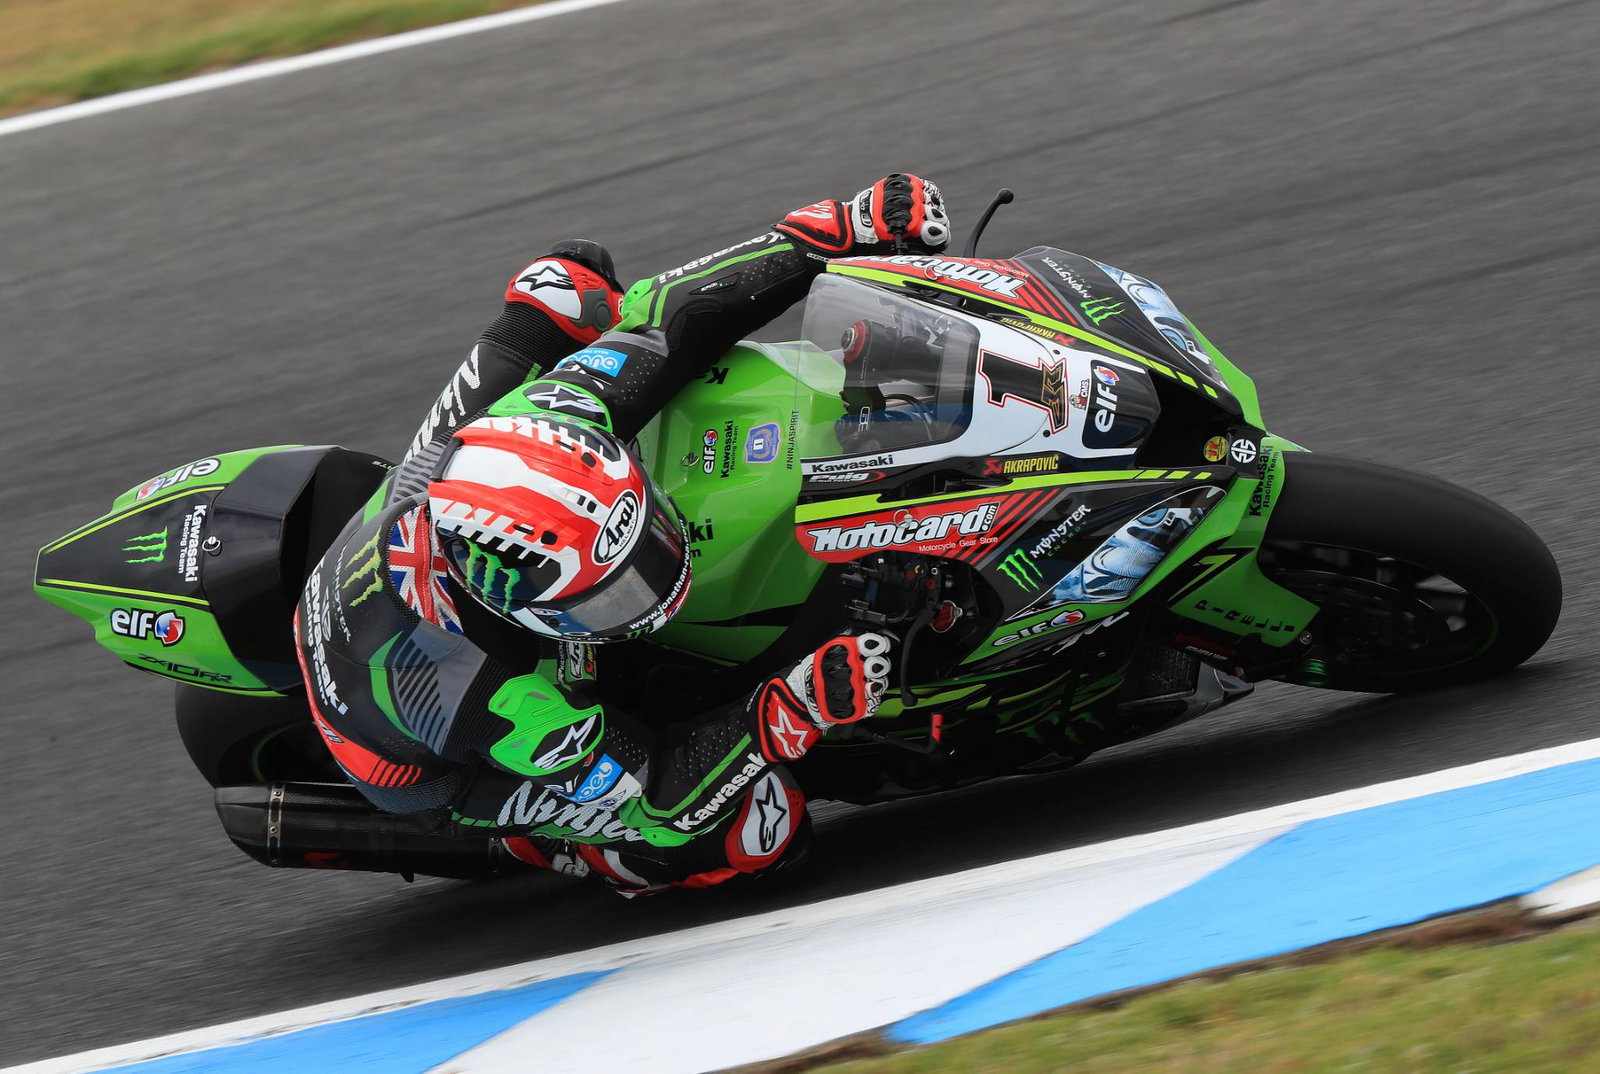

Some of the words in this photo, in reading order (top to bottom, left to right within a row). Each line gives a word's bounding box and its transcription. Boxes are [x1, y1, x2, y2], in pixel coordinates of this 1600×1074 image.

[1094, 383, 1118, 433] elf
[720, 419, 734, 479] Kawasaki
[786, 409, 799, 470] #NINJASPIRIT
[161, 458, 220, 489] elf
[703, 446, 716, 474] elf
[729, 446, 737, 471] Racing
[812, 454, 894, 473] Kawasaki
[1249, 445, 1275, 517] Kawasaki
[1262, 474, 1275, 508] Racing
[180, 514, 193, 547] Racing
[185, 504, 207, 582] Kawasaki
[602, 496, 635, 560] Arai
[919, 541, 957, 552] Motorcycle
[959, 538, 977, 548] Gear
[979, 536, 999, 545] Store
[1029, 504, 1092, 559] MONSTER
[178, 547, 188, 574] Team
[111, 609, 155, 638] elf
[1193, 599, 1296, 633] PIRELLI
[993, 621, 1049, 646] elf
[673, 752, 768, 831] Kawasak
